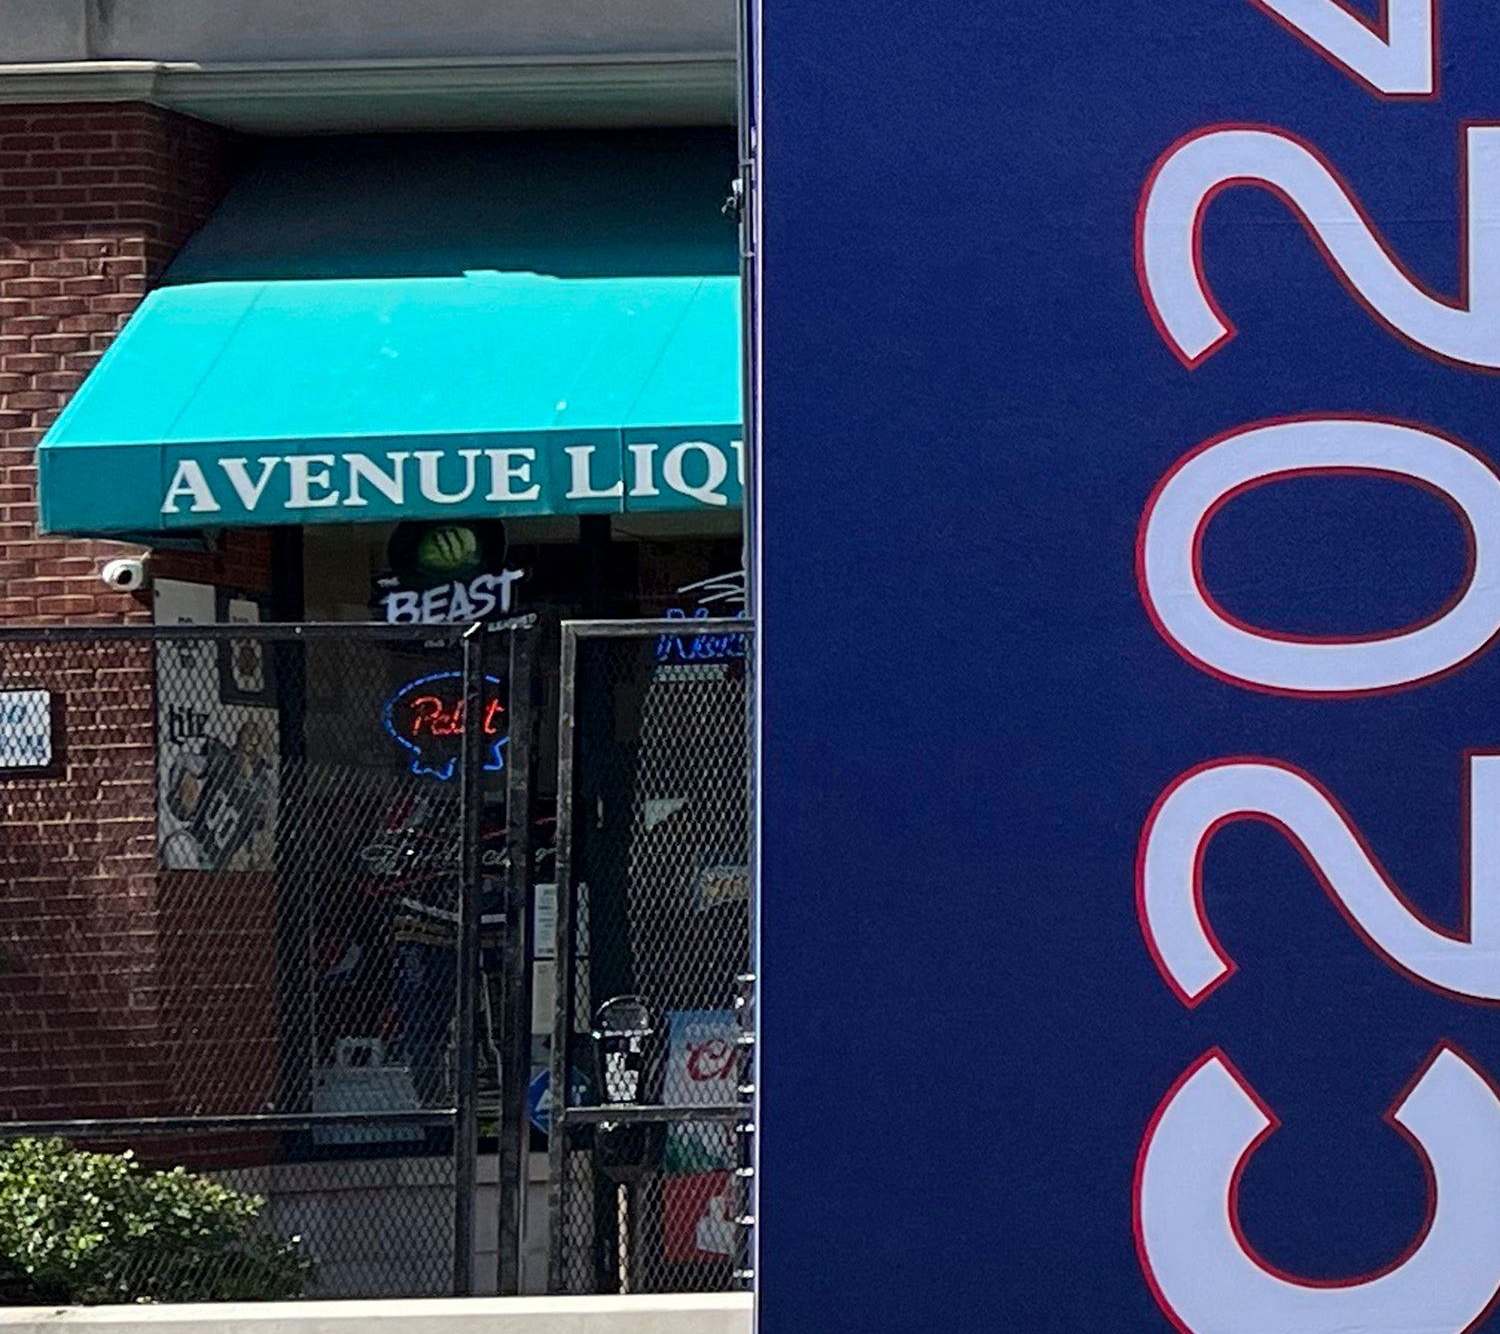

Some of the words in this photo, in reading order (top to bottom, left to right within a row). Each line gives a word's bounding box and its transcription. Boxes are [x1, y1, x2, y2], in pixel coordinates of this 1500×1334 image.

[160, 447, 541, 514] AVENUE
[385, 568, 525, 625] BEAST
[409, 694, 505, 737] Pabt
